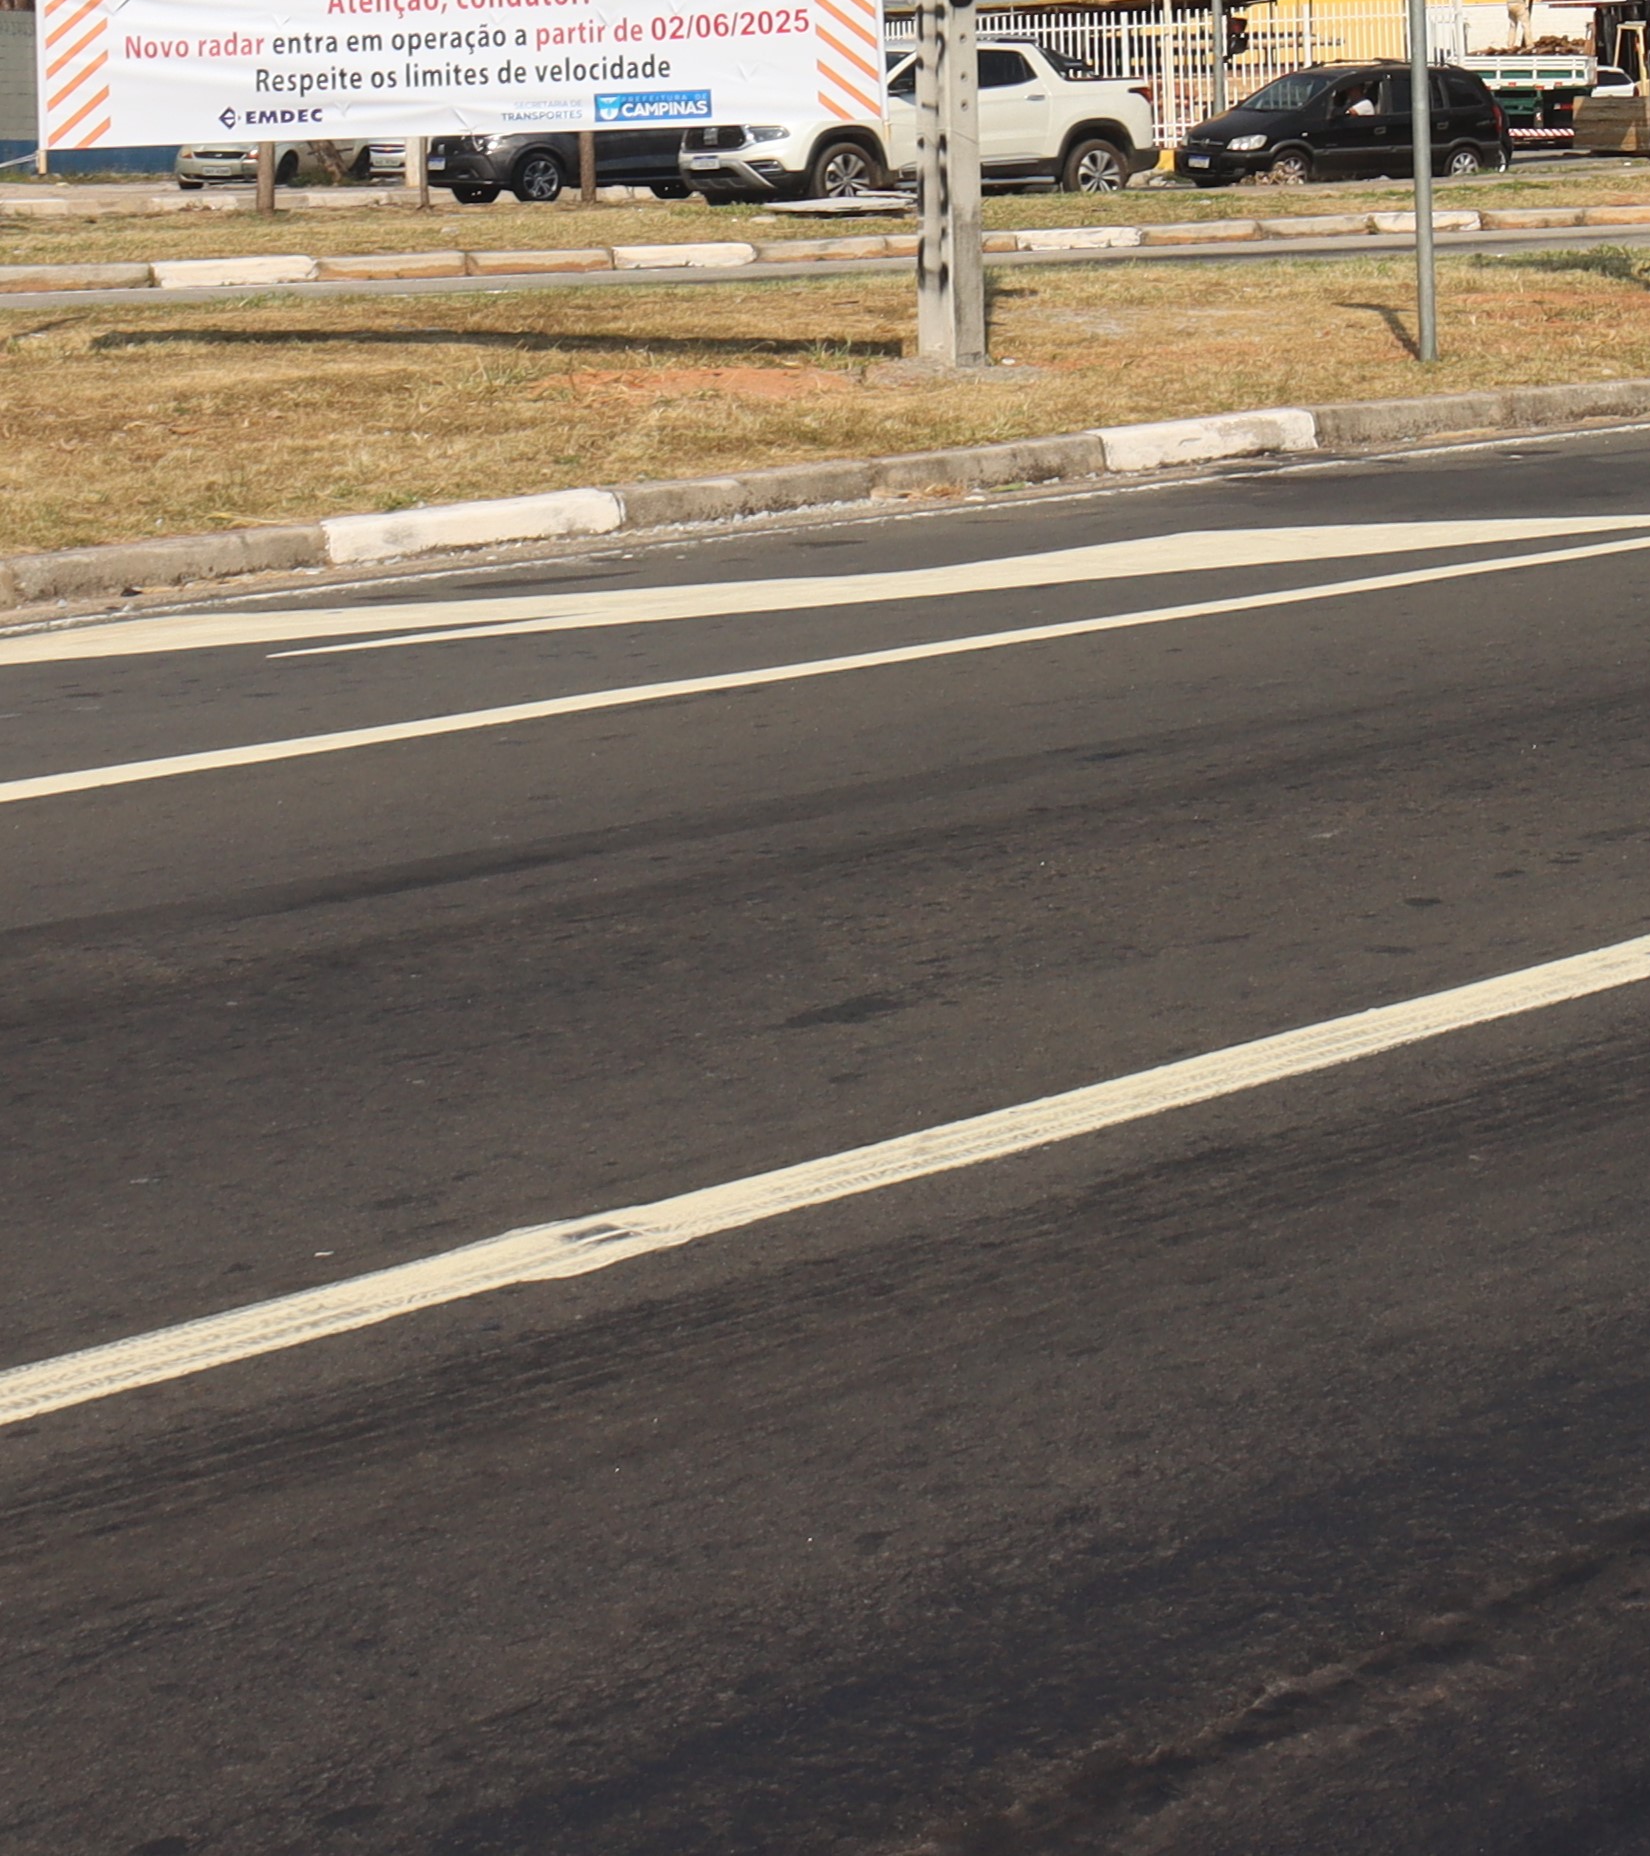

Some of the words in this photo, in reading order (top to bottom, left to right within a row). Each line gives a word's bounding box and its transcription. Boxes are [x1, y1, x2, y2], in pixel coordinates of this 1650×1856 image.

[125, 35, 190, 60] Novo
[197, 32, 265, 58] radar
[272, 32, 338, 55] entra
[346, 35, 383, 53] em
[391, 23, 507, 56] operação
[514, 27, 528, 46] a
[536, 19, 607, 52] partir
[613, 17, 644, 43] de
[650, 7, 810, 42] 02/06/2025
[255, 65, 363, 98] Respeite
[371, 68, 398, 89] os
[405, 61, 489, 88] limites
[497, 59, 527, 85] de
[535, 53, 671, 82] velocidade
[513, 100, 568, 110] SECRETARIA
[570, 99, 582, 108] DE
[620, 94, 688, 103] PREFEITURA
[245, 107, 323, 125] EMDEC
[501, 109, 583, 121] TRANSPORTES
[621, 100, 708, 118] CAMPINAS
